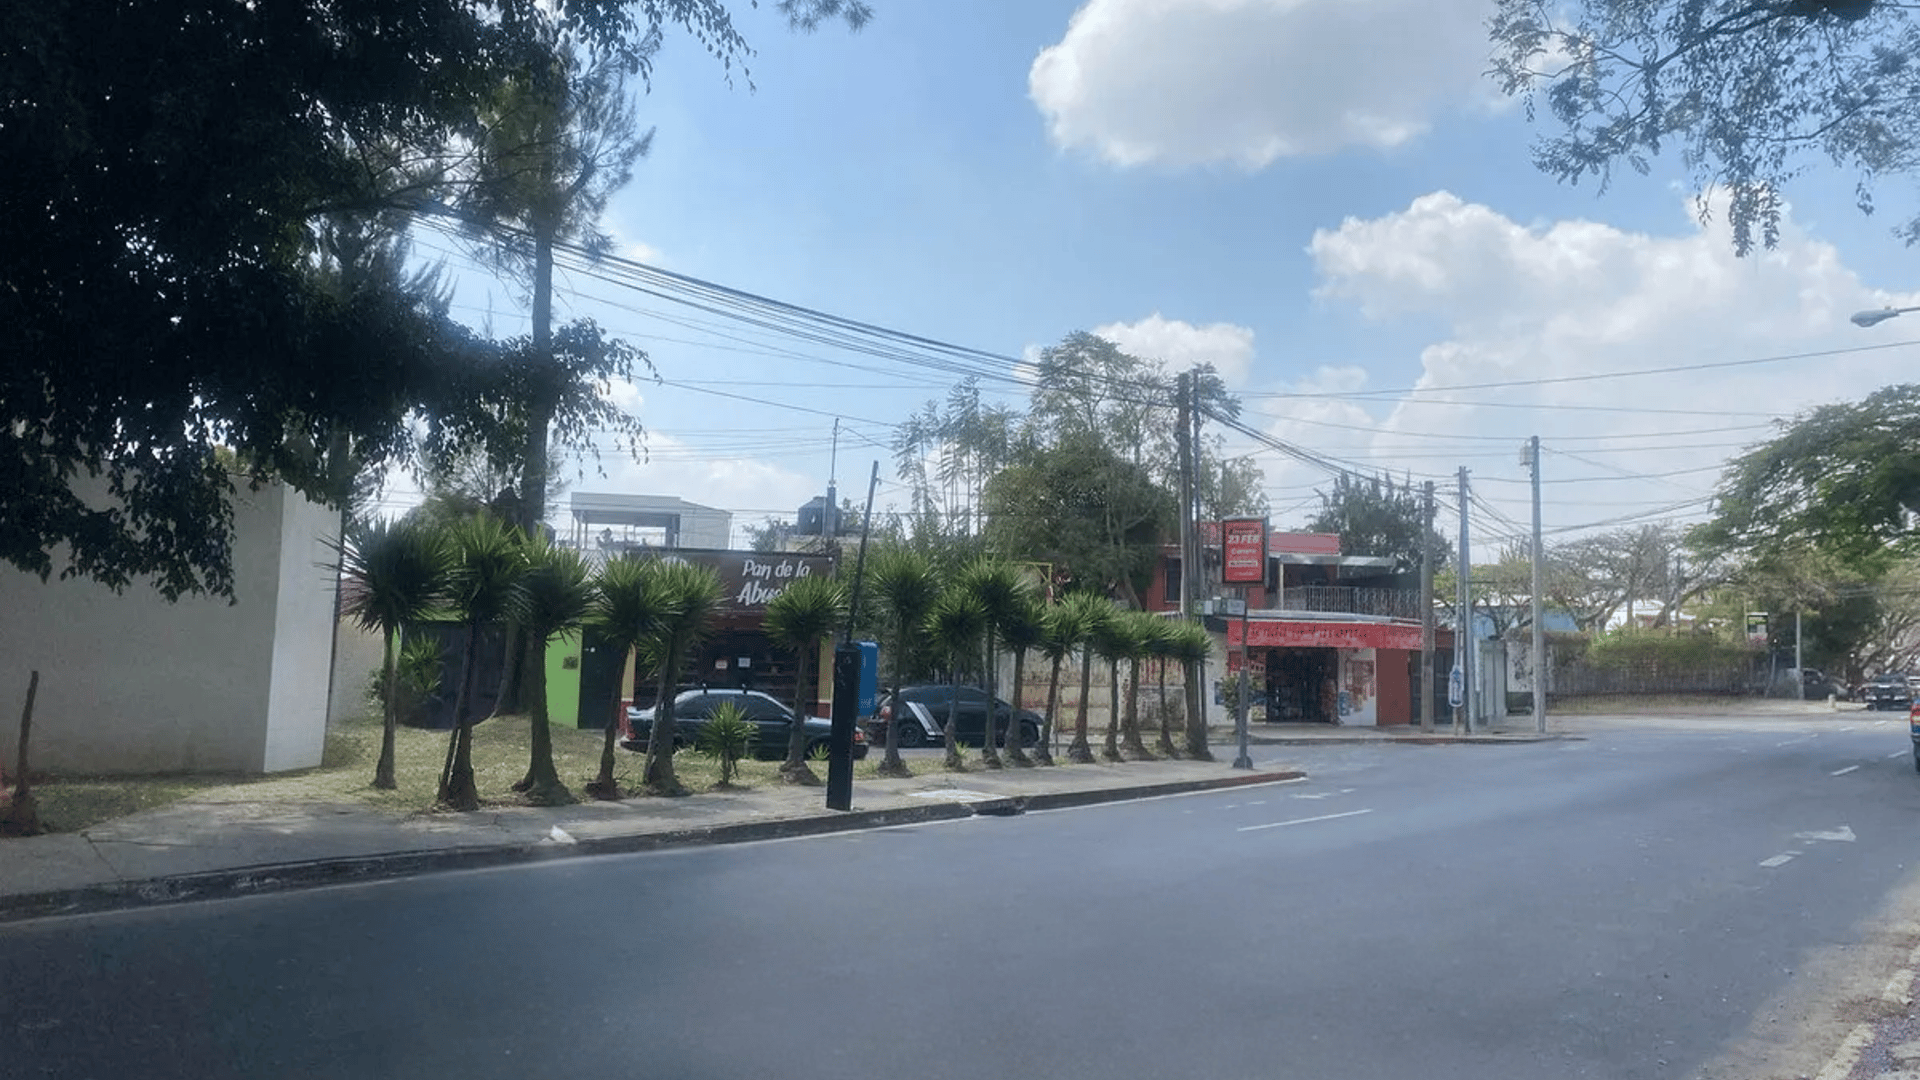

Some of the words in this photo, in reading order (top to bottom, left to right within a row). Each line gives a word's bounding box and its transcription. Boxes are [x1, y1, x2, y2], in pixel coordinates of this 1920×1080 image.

[742, 559, 772, 580] Pan
[775, 560, 793, 578] de
[795, 560, 811, 578] la
[736, 580, 791, 606] Abue
